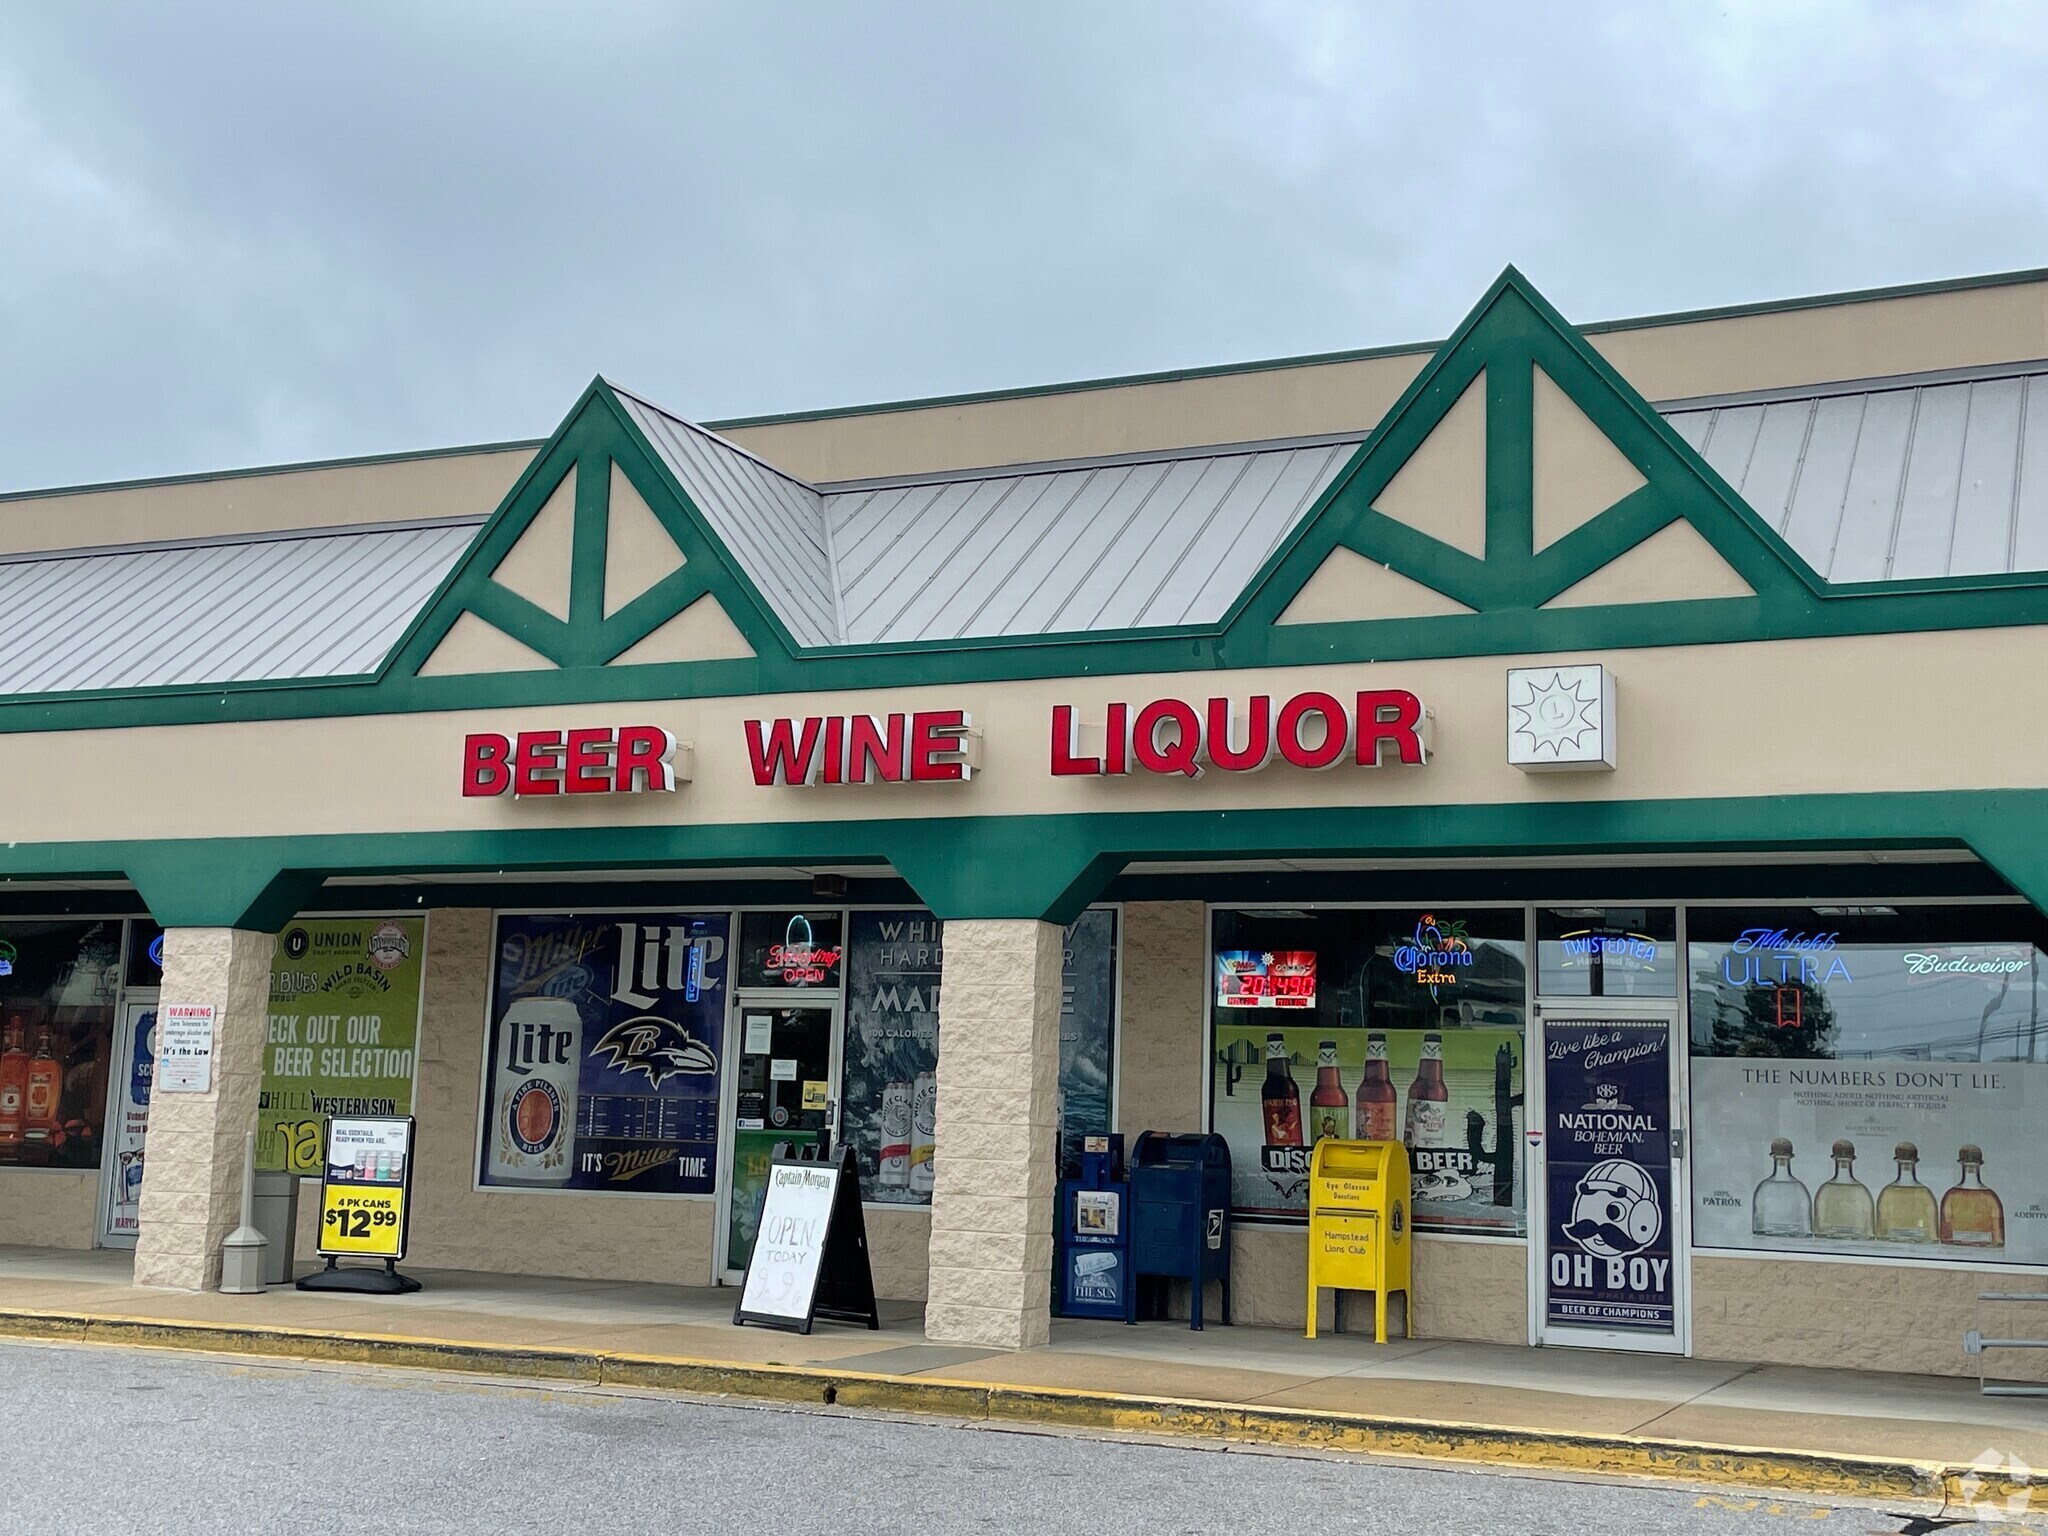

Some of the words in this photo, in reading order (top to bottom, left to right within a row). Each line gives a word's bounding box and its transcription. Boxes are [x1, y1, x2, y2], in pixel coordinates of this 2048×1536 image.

[463, 725, 670, 797] BEER
[744, 710, 965, 786] WINE
[1051, 689, 1424, 778] LIQUOR
[314, 933, 362, 948] UNION
[1561, 937, 1626, 957] TWISTED
[1625, 938, 1656, 962] TEA
[1732, 928, 1840, 953] Michelob
[611, 922, 724, 1009] Lite
[1394, 946, 1473, 974] Corona
[1577, 956, 1600, 966] Hard
[1903, 953, 2031, 974] Budweiser
[322, 964, 352, 993] WILD
[357, 963, 391, 992] BASIN
[784, 968, 824, 982] OPEN
[1416, 969, 1457, 984] Extra
[1723, 955, 1854, 986] ULTRA
[169, 1008, 212, 1017] WARNING
[267, 1015, 299, 1044] ECK
[306, 1015, 341, 1044] OUT
[347, 1015, 382, 1045] OUR
[887, 1030, 933, 1039] CALORIES
[163, 1047, 176, 1055] It's
[179, 1047, 191, 1055] the
[506, 1022, 573, 1075] Lite
[1548, 1040, 1581, 1060] Live
[1583, 1033, 1609, 1051] like
[1611, 1031, 1623, 1043] a
[1584, 1033, 1667, 1070] Champion!
[273, 1047, 314, 1077] BEER
[320, 1048, 413, 1080] SELECTION
[1742, 1069, 1781, 1084] THE
[1789, 1070, 1886, 1087] NUMBERS
[1895, 1072, 1962, 1089] DON'T
[1972, 1074, 2007, 1089] LIE.
[1596, 1084, 1618, 1098] 1885
[1793, 1091, 1832, 1099] NOTHING
[1864, 1093, 1904, 1101] NOTHING
[311, 1097, 370, 1115] WESTERN
[371, 1098, 397, 1116] SON
[1796, 1099, 1835, 1107] NOTHING
[1877, 1101, 1911, 1109] PERFECT
[1913, 1102, 1947, 1110] TEQUILA
[1559, 1113, 1658, 1131] NATIONAL
[521, 1143, 546, 1154] BEER
[1594, 1143, 1623, 1155] BEER
[582, 1153, 603, 1173] IT'S
[604, 1148, 680, 1181] Miller
[1417, 1149, 1473, 1172] BEER
[776, 1168, 802, 1188] Captain
[801, 1169, 831, 1190] Morgan
[1326, 1183, 1338, 1191] Eye
[1343, 1183, 1370, 1191] Glasses
[338, 1199, 345, 1207] 4
[347, 1199, 361, 1207] PK
[363, 1200, 391, 1208] CANS
[1702, 1196, 1742, 1208] PATRÓN
[768, 1216, 817, 1250] OPEN
[1325, 1231, 1369, 1242] Hampstead
[766, 1250, 807, 1265] TODAY
[1325, 1245, 1345, 1253] Lions
[1348, 1245, 1366, 1255] Club
[1551, 1253, 1593, 1288] OH
[1607, 1256, 1669, 1292] BOY
[1074, 1286, 1095, 1298] THE
[1096, 1286, 1116, 1299] SUN
[1561, 1305, 1586, 1314] BEER
[1588, 1306, 1601, 1315] OF
[1602, 1307, 1660, 1319] CHAMPIONS
